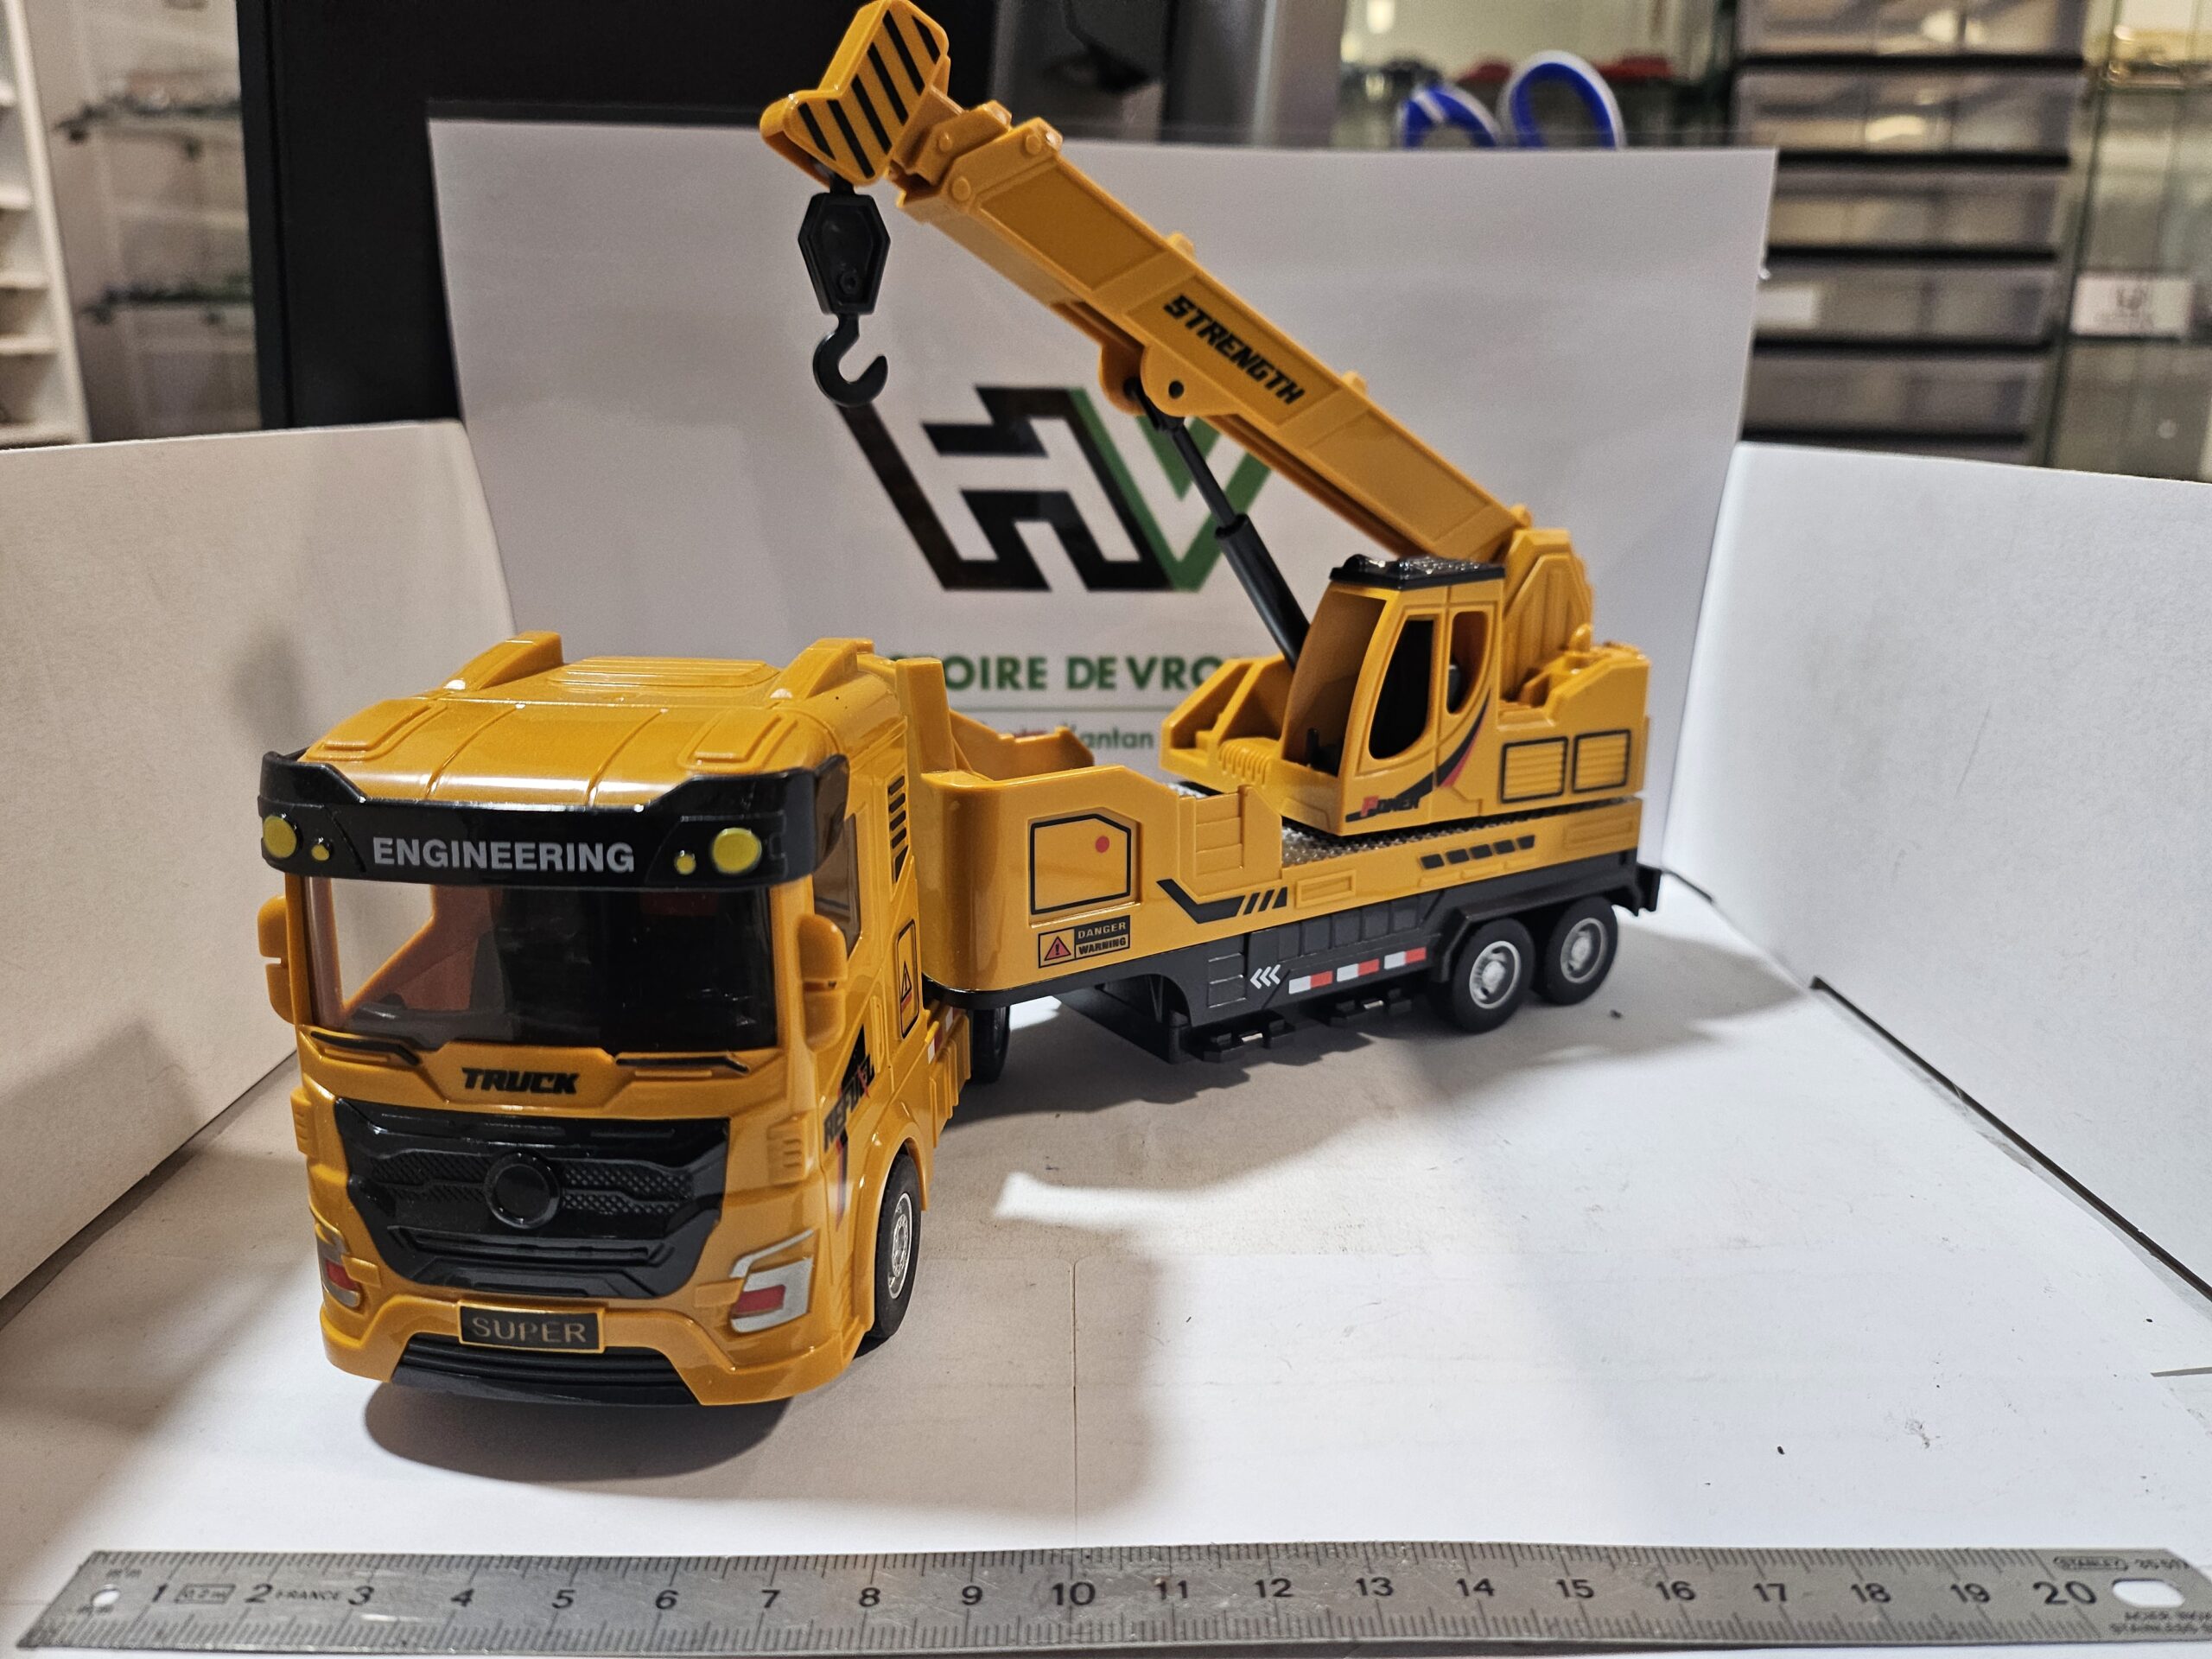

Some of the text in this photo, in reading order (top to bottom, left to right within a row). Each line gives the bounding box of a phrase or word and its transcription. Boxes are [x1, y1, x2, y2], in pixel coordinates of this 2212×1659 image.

[1163, 294, 1306, 405] STRENGTH
[888, 654, 1227, 691] OIRE DE VRO
[372, 836, 635, 873] ENGINEERING
[1077, 922, 1127, 939] DANGER
[1078, 937, 1127, 956] WARNING
[461, 1066, 580, 1095] TRUCK
[471, 1316, 587, 1344] SUPER
[152, 1583, 168, 1603] 1
[245, 1583, 273, 1604] 2
[348, 1585, 375, 1605] 3
[451, 1588, 474, 1608] 4
[552, 1589, 576, 1610] 5
[655, 1589, 678, 1610] 6
[761, 1589, 780, 1609] 7
[858, 1587, 881, 1608] 8
[962, 1586, 982, 1606] 9
[1052, 1582, 1096, 1605] 10
[1155, 1580, 1188, 1600] 11
[1255, 1578, 1292, 1599] 12
[1355, 1577, 1394, 1598] 13
[1455, 1578, 1496, 1598] 14
[1555, 1579, 1595, 1599] 15
[1656, 1580, 1695, 1602] 16
[1753, 1582, 1787, 1602] 17
[1851, 1583, 1891, 1604] 18
[1950, 1582, 1990, 1604] 19
[2033, 1581, 2097, 1605] 20
